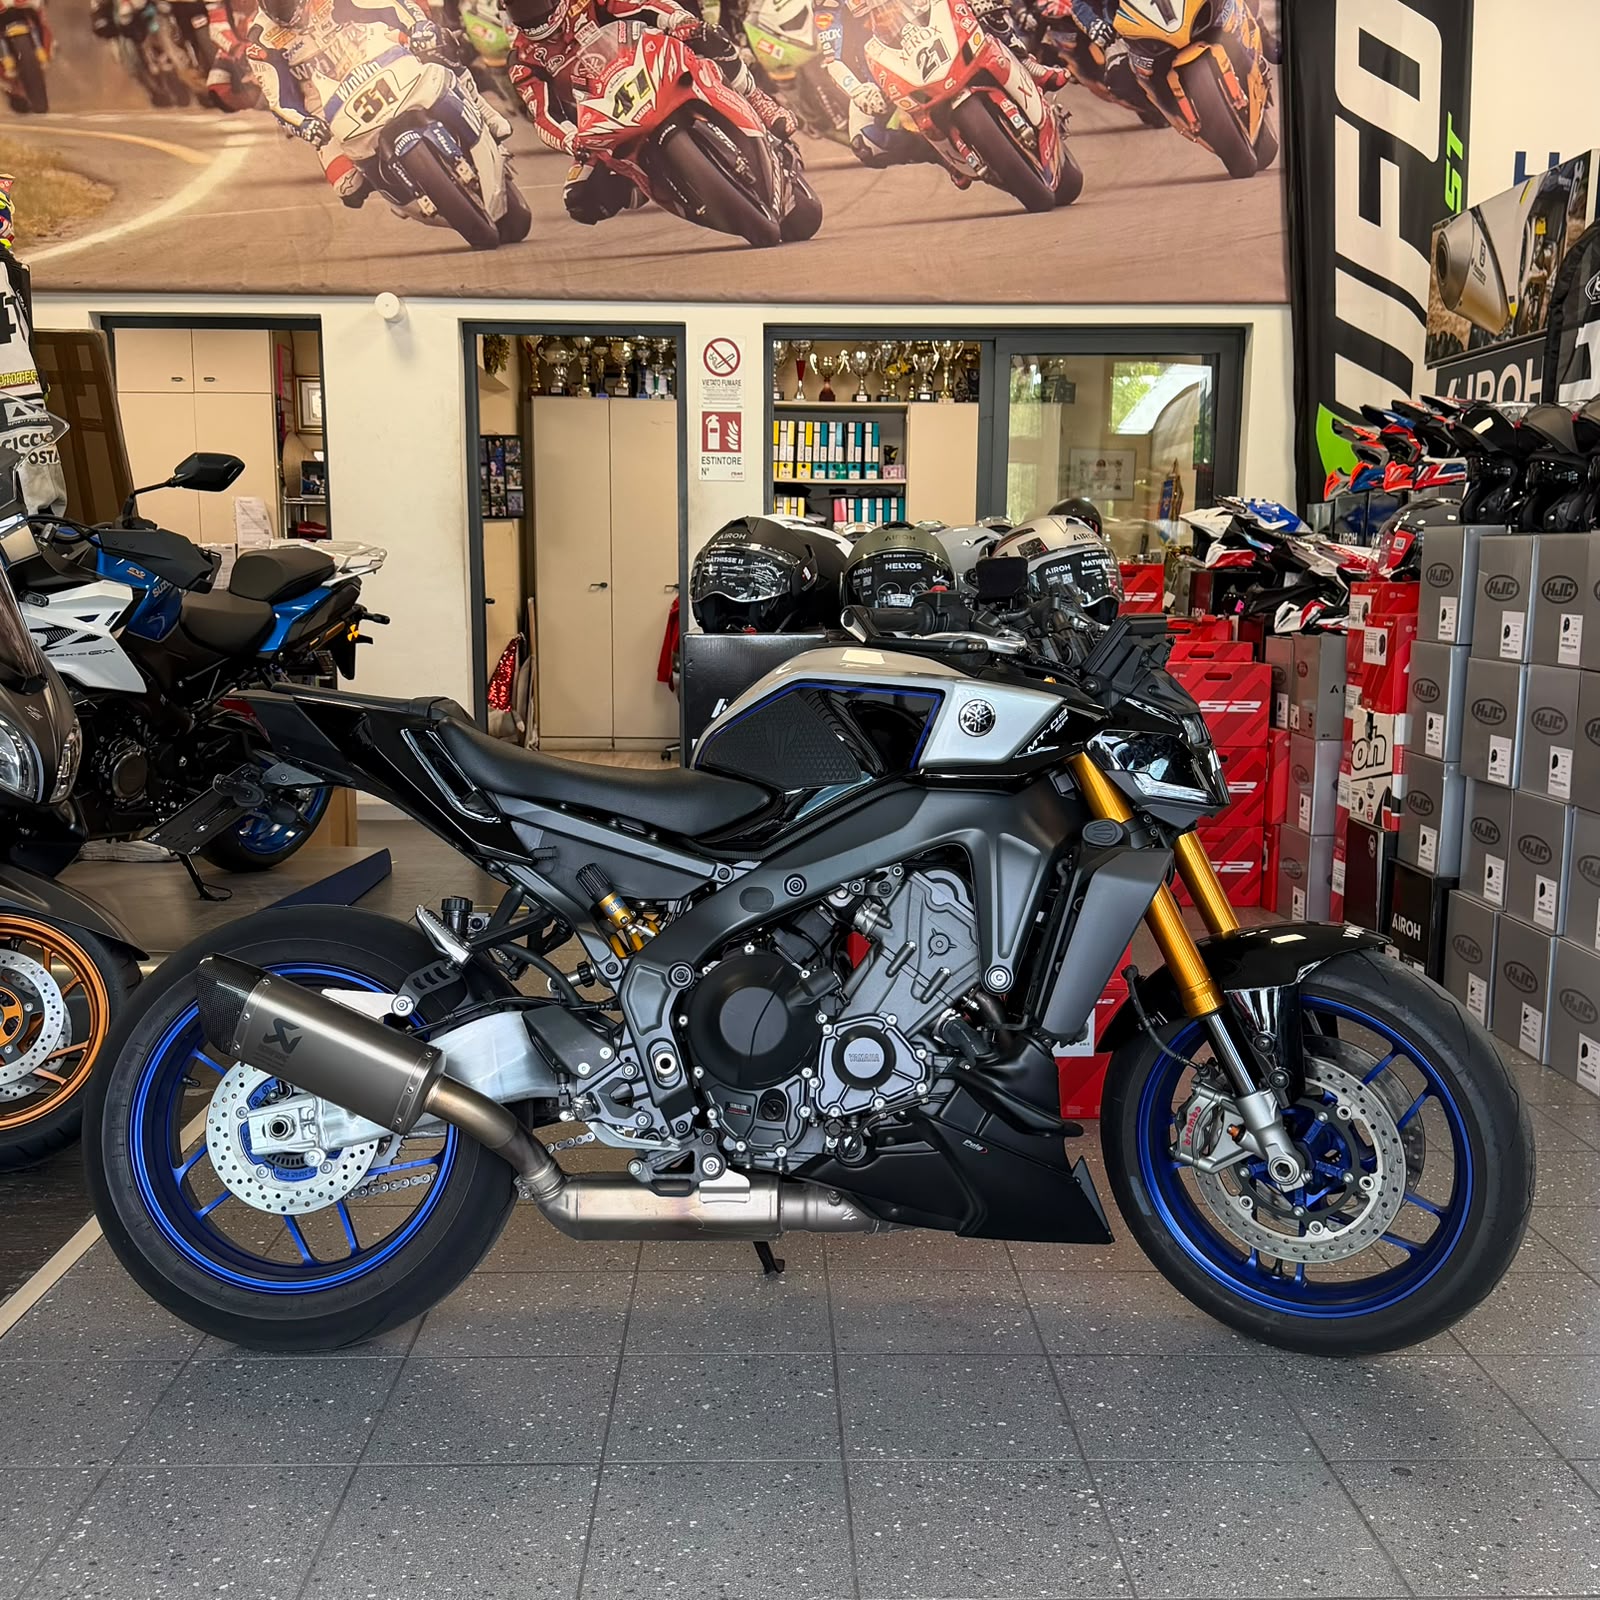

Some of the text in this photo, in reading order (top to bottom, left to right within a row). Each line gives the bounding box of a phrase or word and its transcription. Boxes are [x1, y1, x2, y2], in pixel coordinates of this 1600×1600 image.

[916, 37, 951, 82] 21
[353, 78, 399, 124] 31
[701, 456, 742, 465] ESTINTORE
[718, 533, 747, 541] AIROH
[853, 566, 873, 577] AIROH
[885, 562, 922, 570] HELYOS
[1045, 564, 1071, 575] AIROH
[1430, 569, 1450, 579] HJC
[1488, 580, 1516, 596] HJC
[1546, 581, 1574, 597] HJC
[1414, 685, 1437, 698] HJC
[1198, 700, 1262, 713] S2
[1475, 703, 1504, 721] HJC
[1027, 707, 1068, 754] MT-09
[1534, 713, 1564, 730] HJC
[1409, 793, 1432, 811] HJC
[1473, 820, 1498, 841] HJC
[1521, 839, 1549, 861] HJC
[1392, 913, 1421, 941] AIROH
[1455, 938, 1480, 961] HJC
[1506, 967, 1535, 991] HJC
[1563, 995, 1595, 1020] HJC
[1184, 1106, 1201, 1146] brembo
